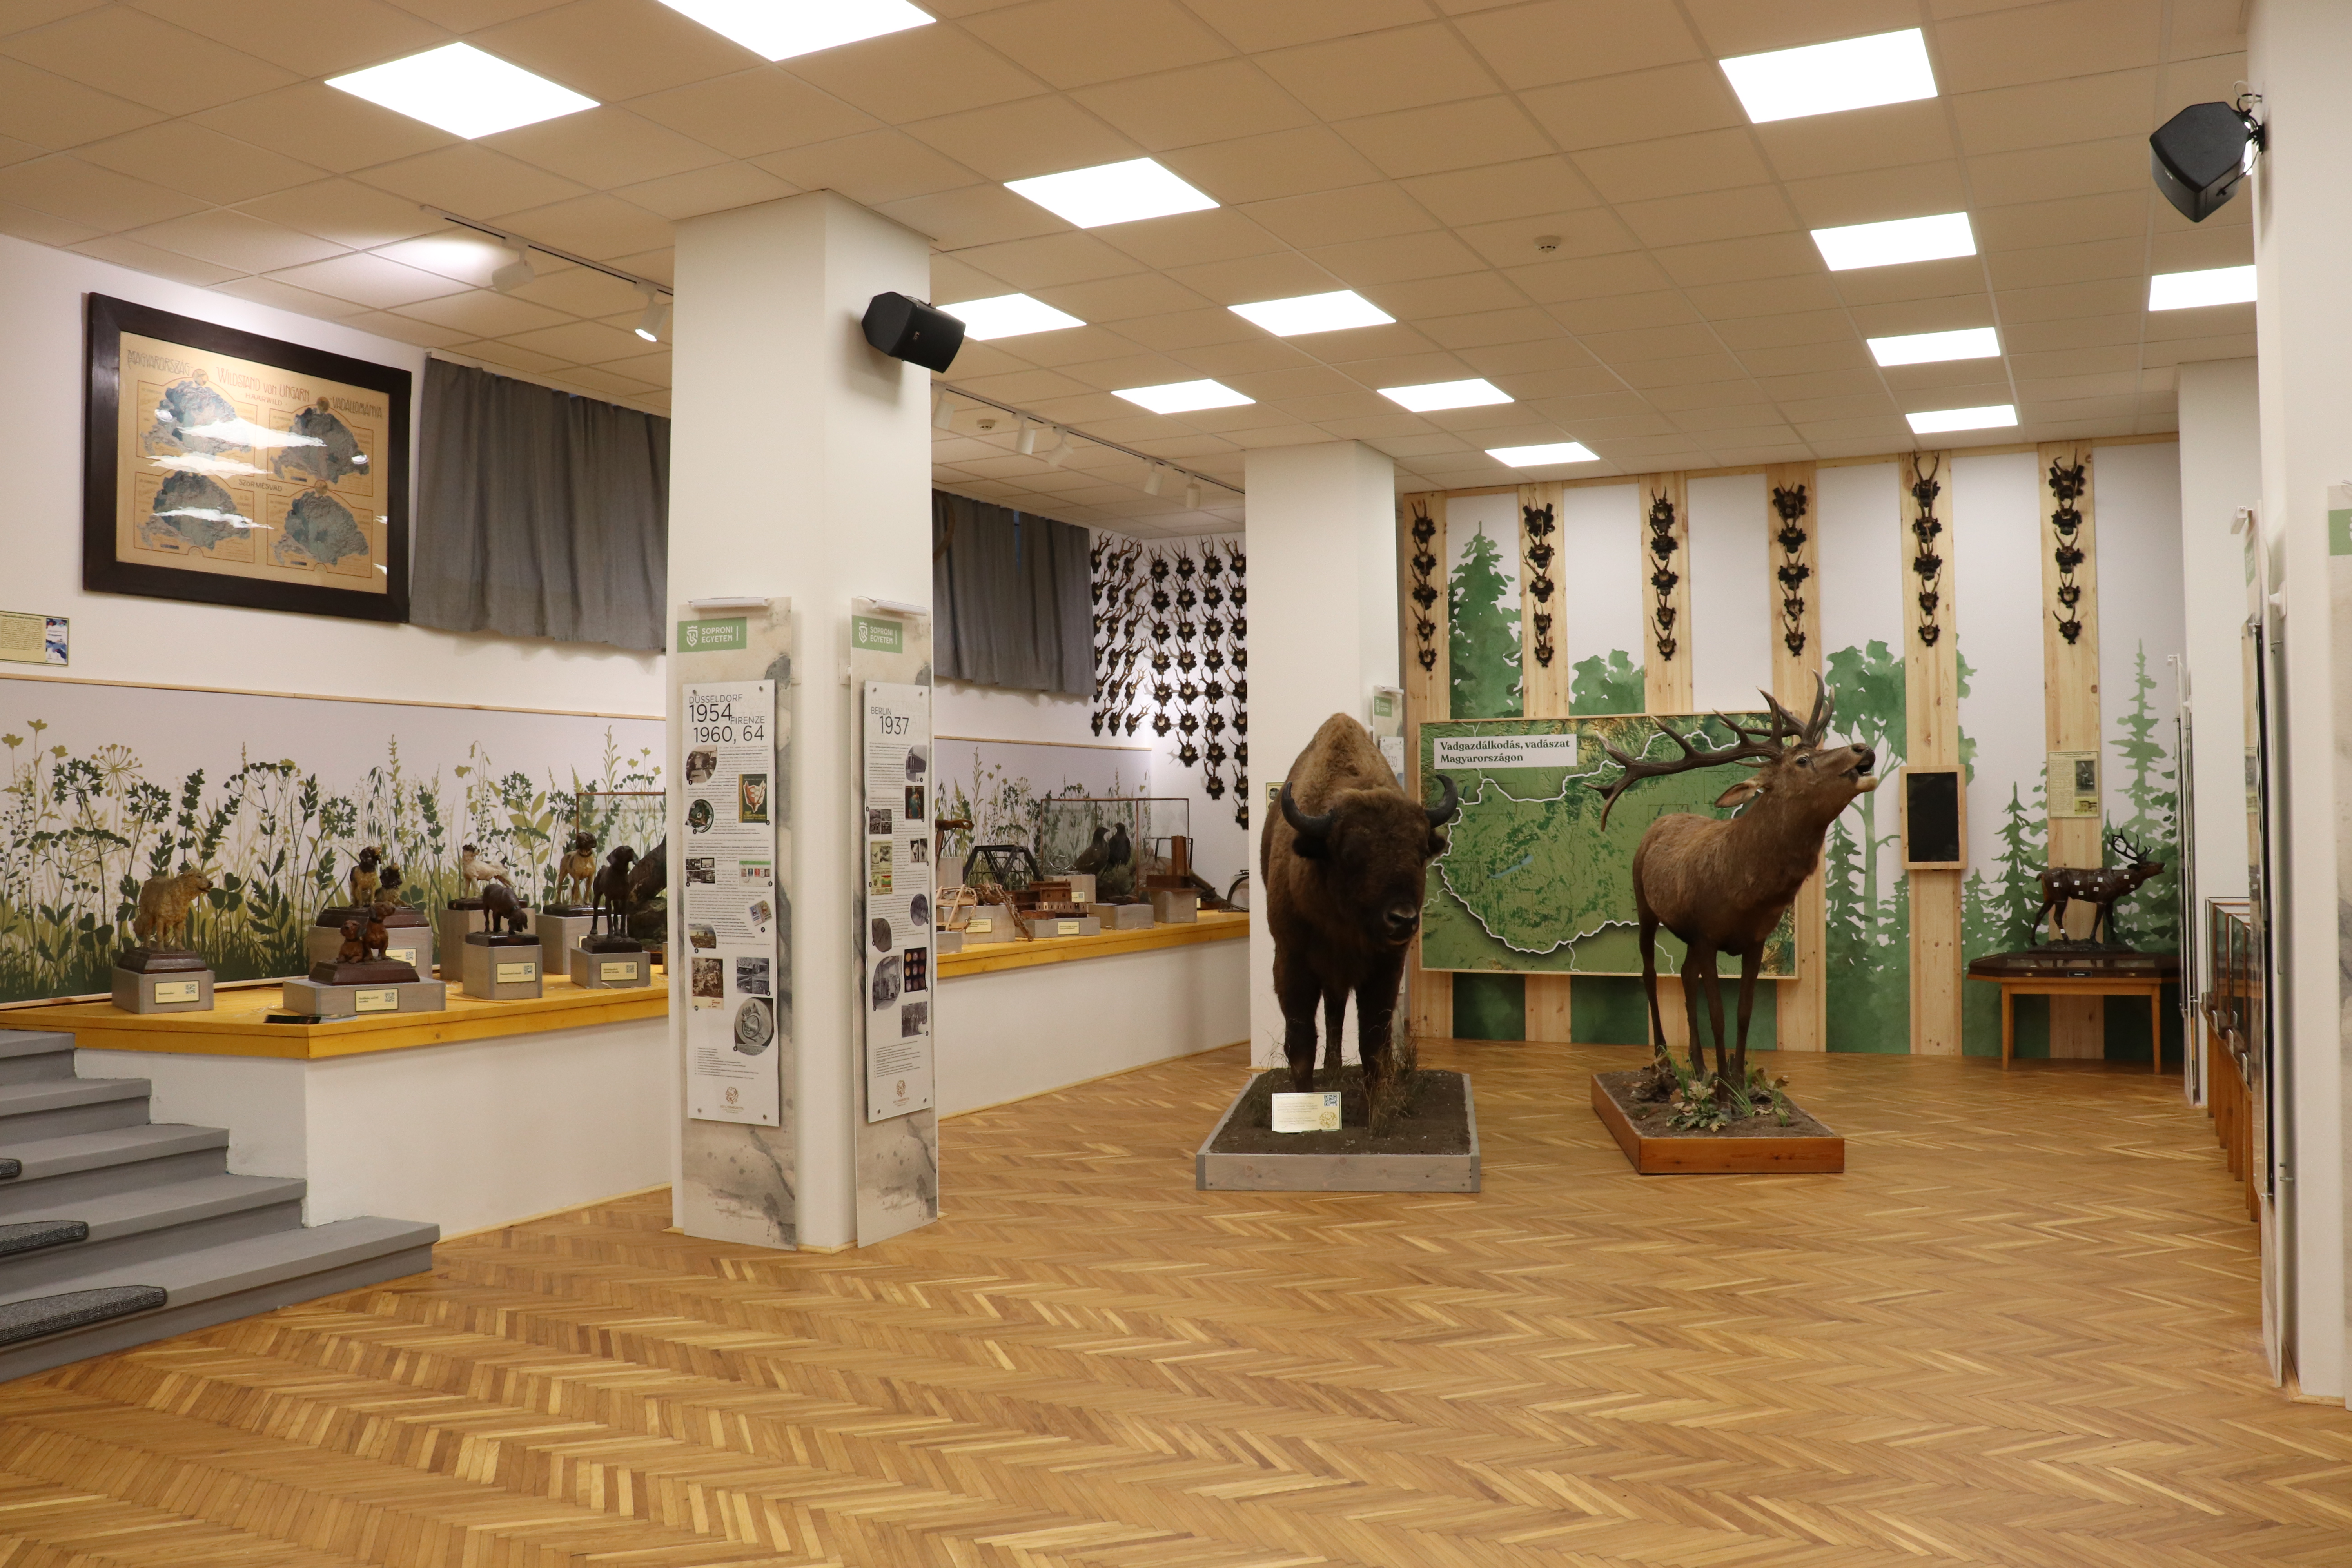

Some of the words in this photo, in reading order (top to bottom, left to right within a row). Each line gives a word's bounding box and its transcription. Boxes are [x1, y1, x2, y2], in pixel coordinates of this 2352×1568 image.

[216, 367, 261, 391] WILDSTAND
[279, 383, 310, 402] UNGARN
[245, 392, 282, 405] HAARWILD
[701, 626, 733, 635] SOPRONI
[870, 626, 893, 636] SOPRONI
[701, 634, 733, 643] EGYETEM
[870, 634, 893, 645] EGYETEM
[689, 694, 743, 704] DÜSSELDORF
[689, 703, 732, 723] 1954
[871, 706, 892, 715] BERLIN
[730, 716, 765, 725] FIRENZE
[879, 716, 909, 735] 1937
[693, 726, 736, 744] 1960,
[743, 725, 764, 742] 64
[1440, 740, 1524, 751] Vadgazdálkodás,
[1525, 739, 1570, 749] vadászat
[1386, 756, 1398, 768] 930
[1440, 753, 1524, 765] Magyarországon
